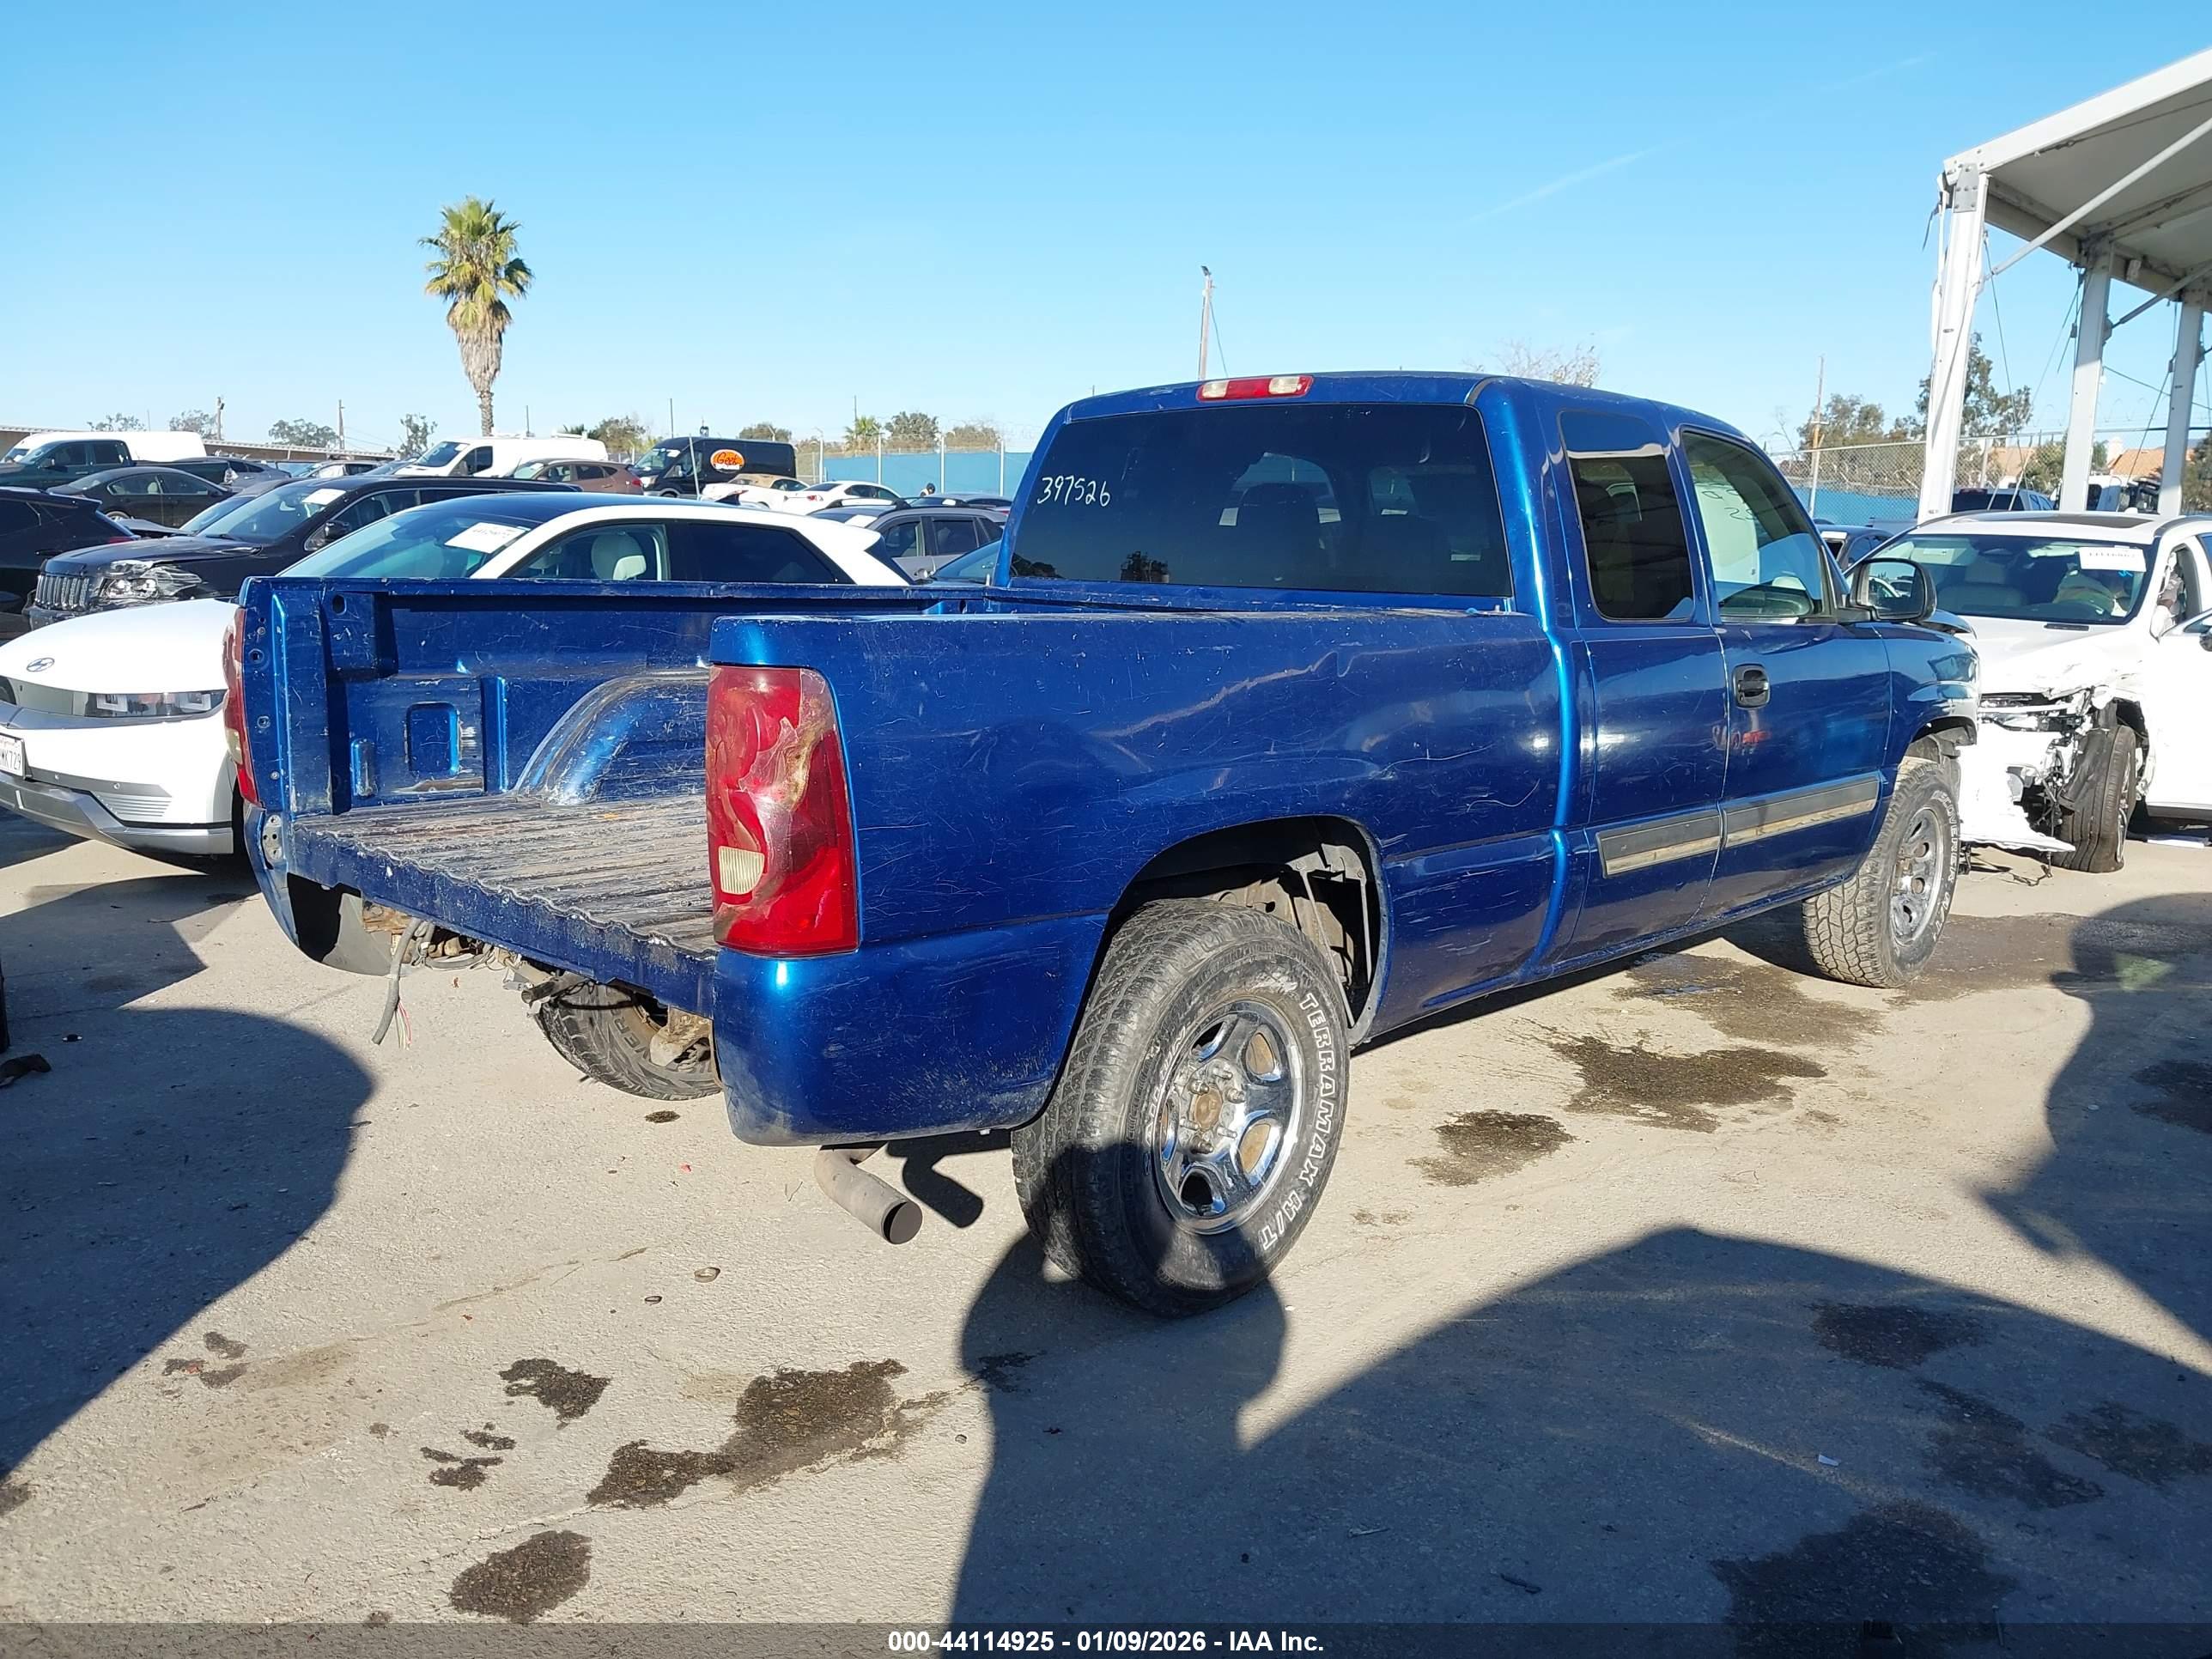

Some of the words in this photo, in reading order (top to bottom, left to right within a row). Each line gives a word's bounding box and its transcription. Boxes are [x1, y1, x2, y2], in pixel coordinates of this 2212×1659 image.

[1037, 475, 1111, 507] 397526
[0, 748, 21, 771] MK729
[1299, 993, 1335, 1187] TERRAMAX
[1259, 1189, 1303, 1251] H/T
